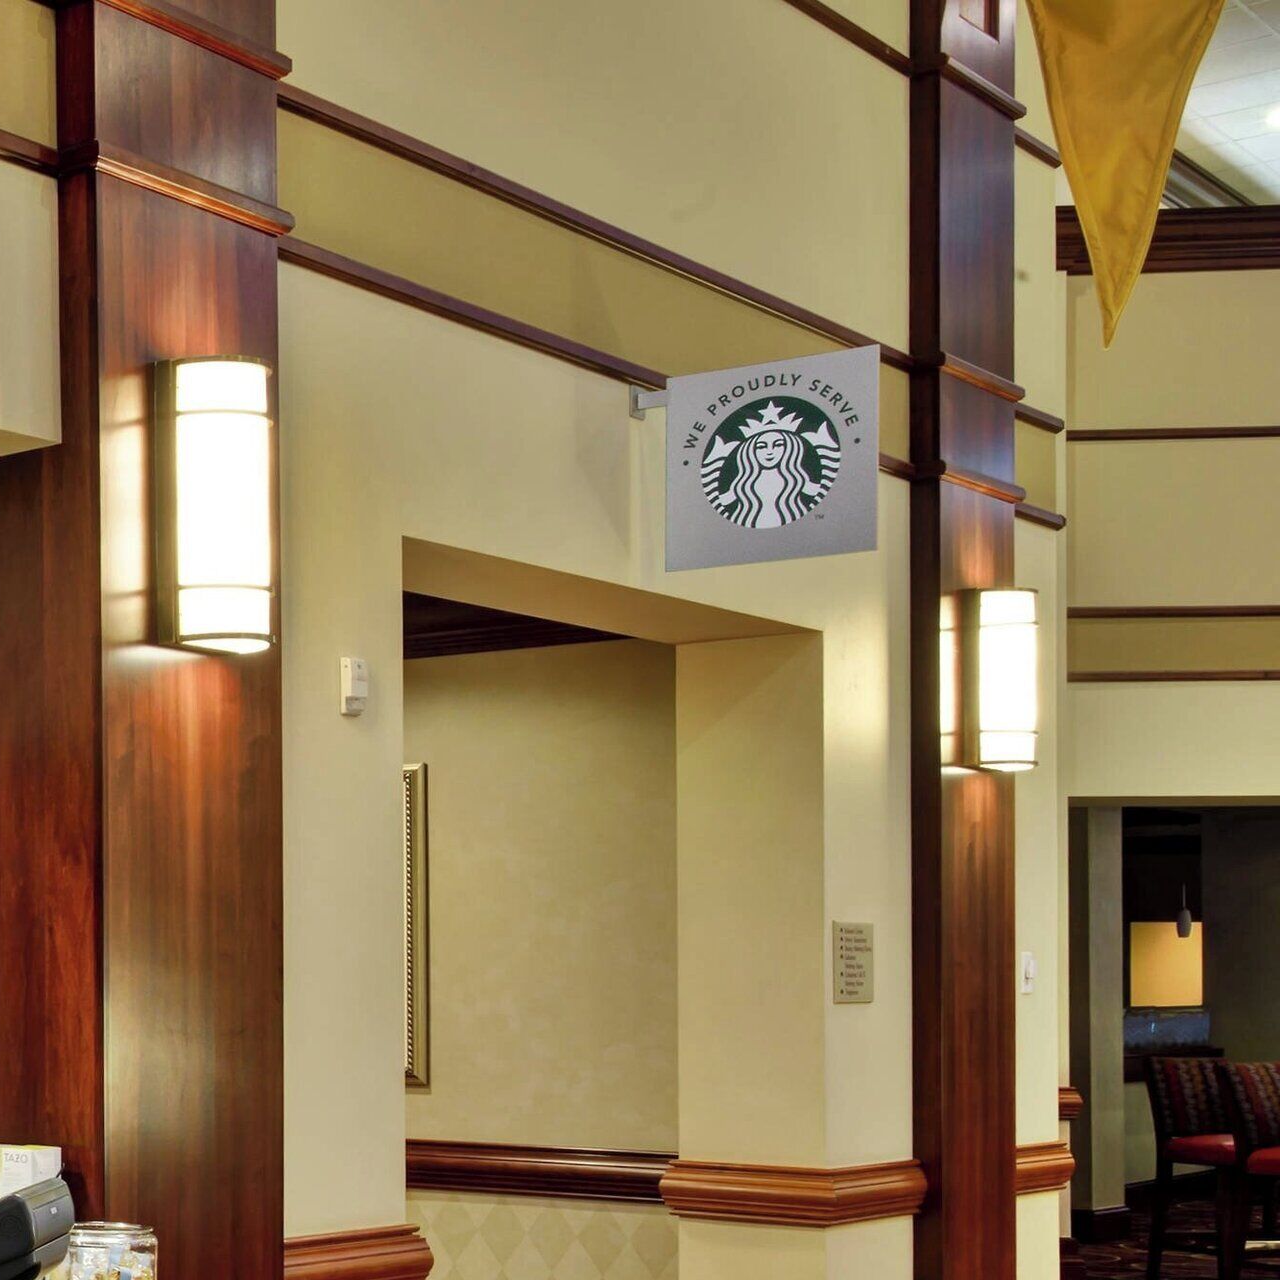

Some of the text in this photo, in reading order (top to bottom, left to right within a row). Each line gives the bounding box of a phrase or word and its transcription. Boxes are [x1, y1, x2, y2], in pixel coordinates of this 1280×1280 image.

[684, 373, 859, 450] WE PROUDLY SERVE
